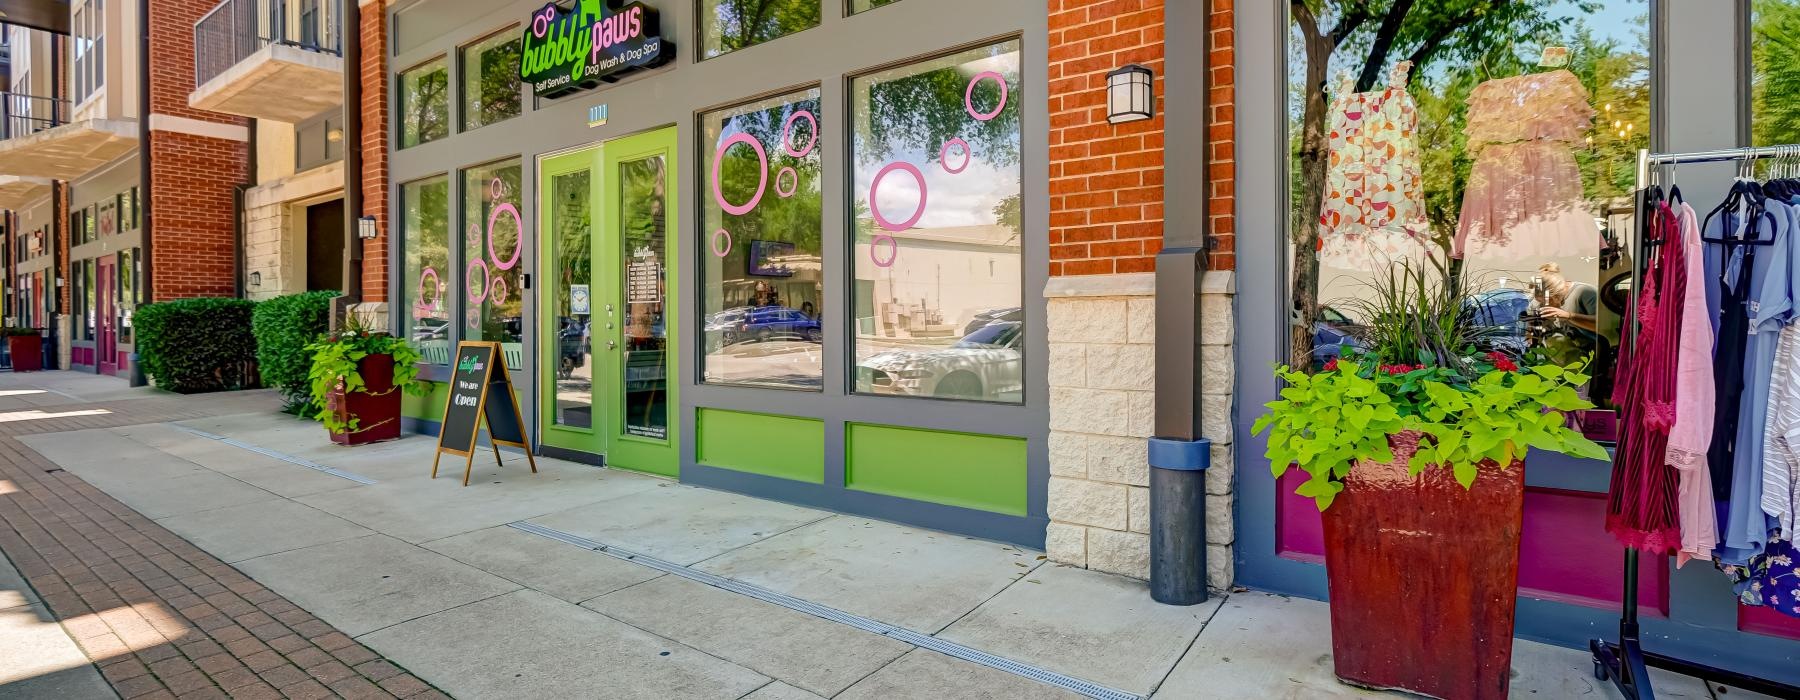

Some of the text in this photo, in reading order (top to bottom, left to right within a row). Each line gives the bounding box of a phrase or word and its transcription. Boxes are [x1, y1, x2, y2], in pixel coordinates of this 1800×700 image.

[522, 6, 640, 81] bubbly paws
[536, 42, 657, 92] Self Service Dog Wash & Dog Spa
[455, 393, 477, 407] Open
